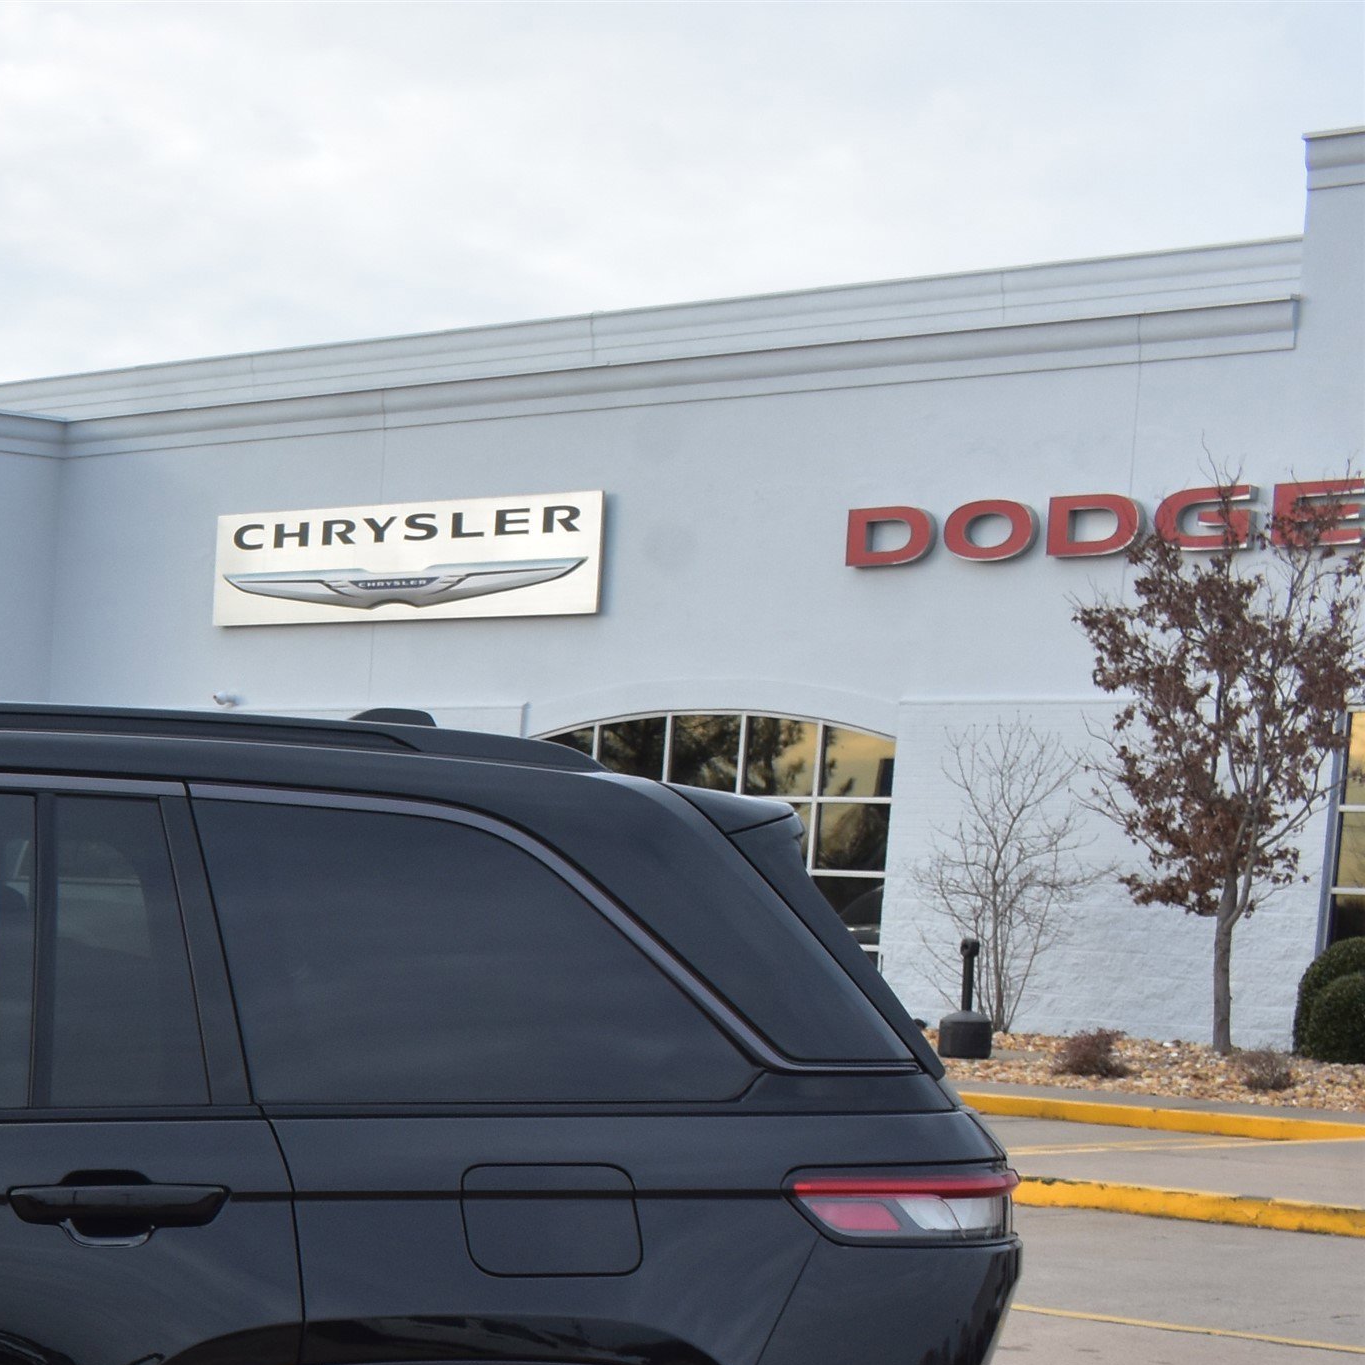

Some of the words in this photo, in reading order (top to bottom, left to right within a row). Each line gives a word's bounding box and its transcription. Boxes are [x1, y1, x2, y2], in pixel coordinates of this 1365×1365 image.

[233, 505, 581, 550] CHRYSLER
[845, 478, 1365, 568] DODGE
[358, 579, 427, 588] CHRYSLER
